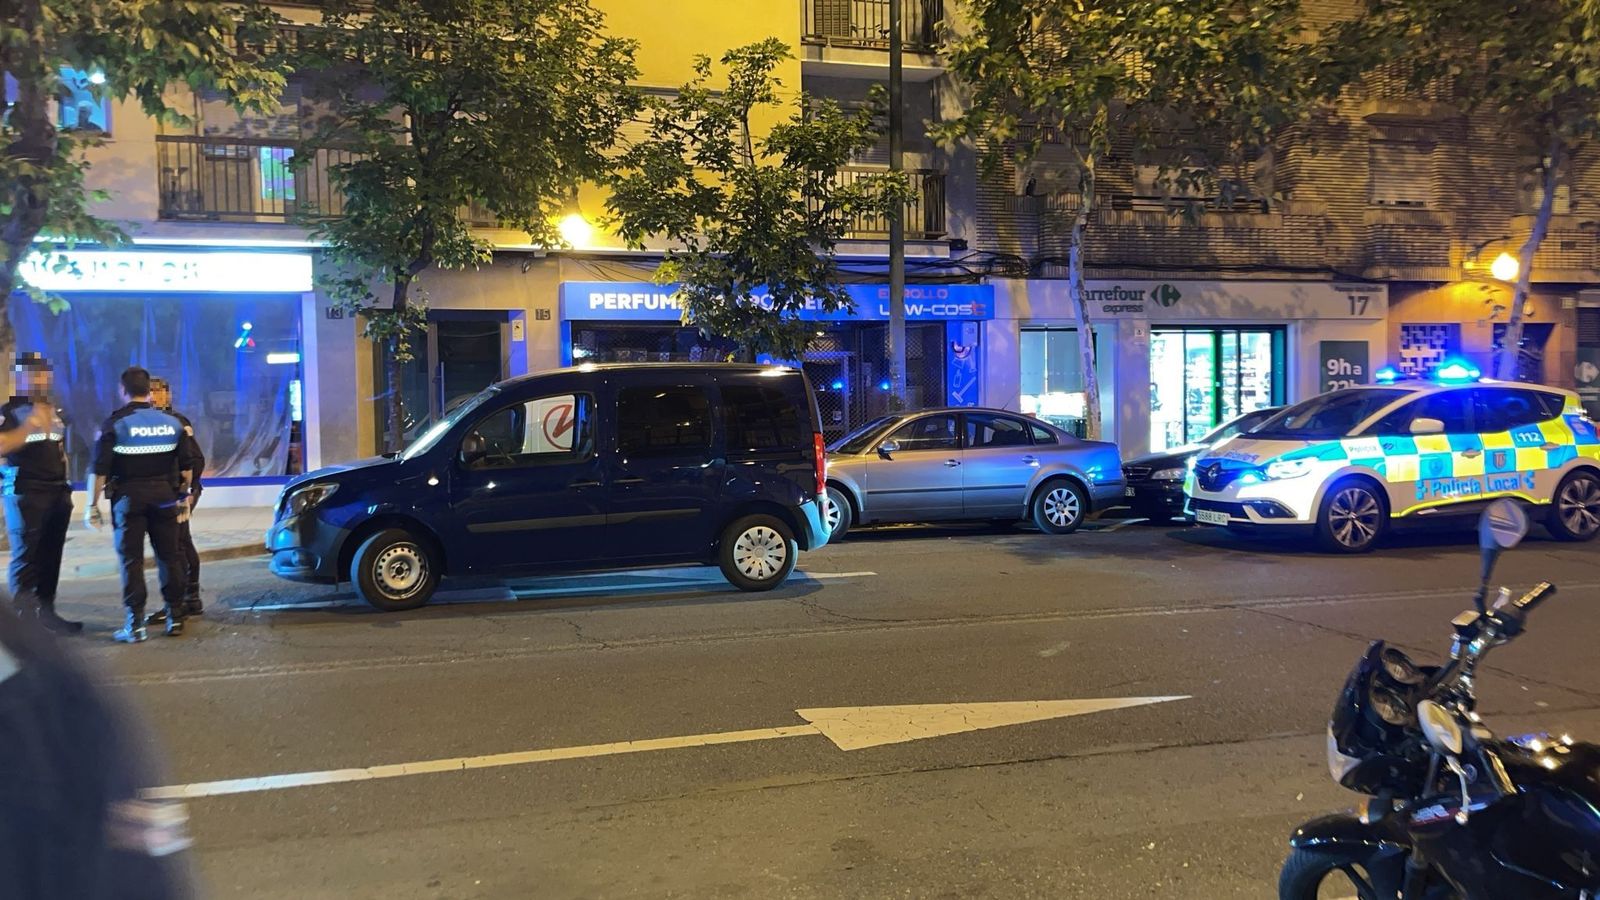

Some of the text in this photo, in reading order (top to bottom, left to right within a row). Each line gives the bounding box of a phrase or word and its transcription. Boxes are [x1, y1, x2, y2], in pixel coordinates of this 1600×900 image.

[1070, 285, 1146, 301] arrefour
[589, 292, 694, 310] PERFUM
[1347, 295, 1369, 316] 17
[328, 308, 342, 319] 13
[536, 309, 551, 320] 15
[1103, 304, 1144, 316] express
[130, 424, 176, 438] POLICÍA
[1518, 431, 1541, 443] 112
[1430, 473, 1521, 497] Policía Local
